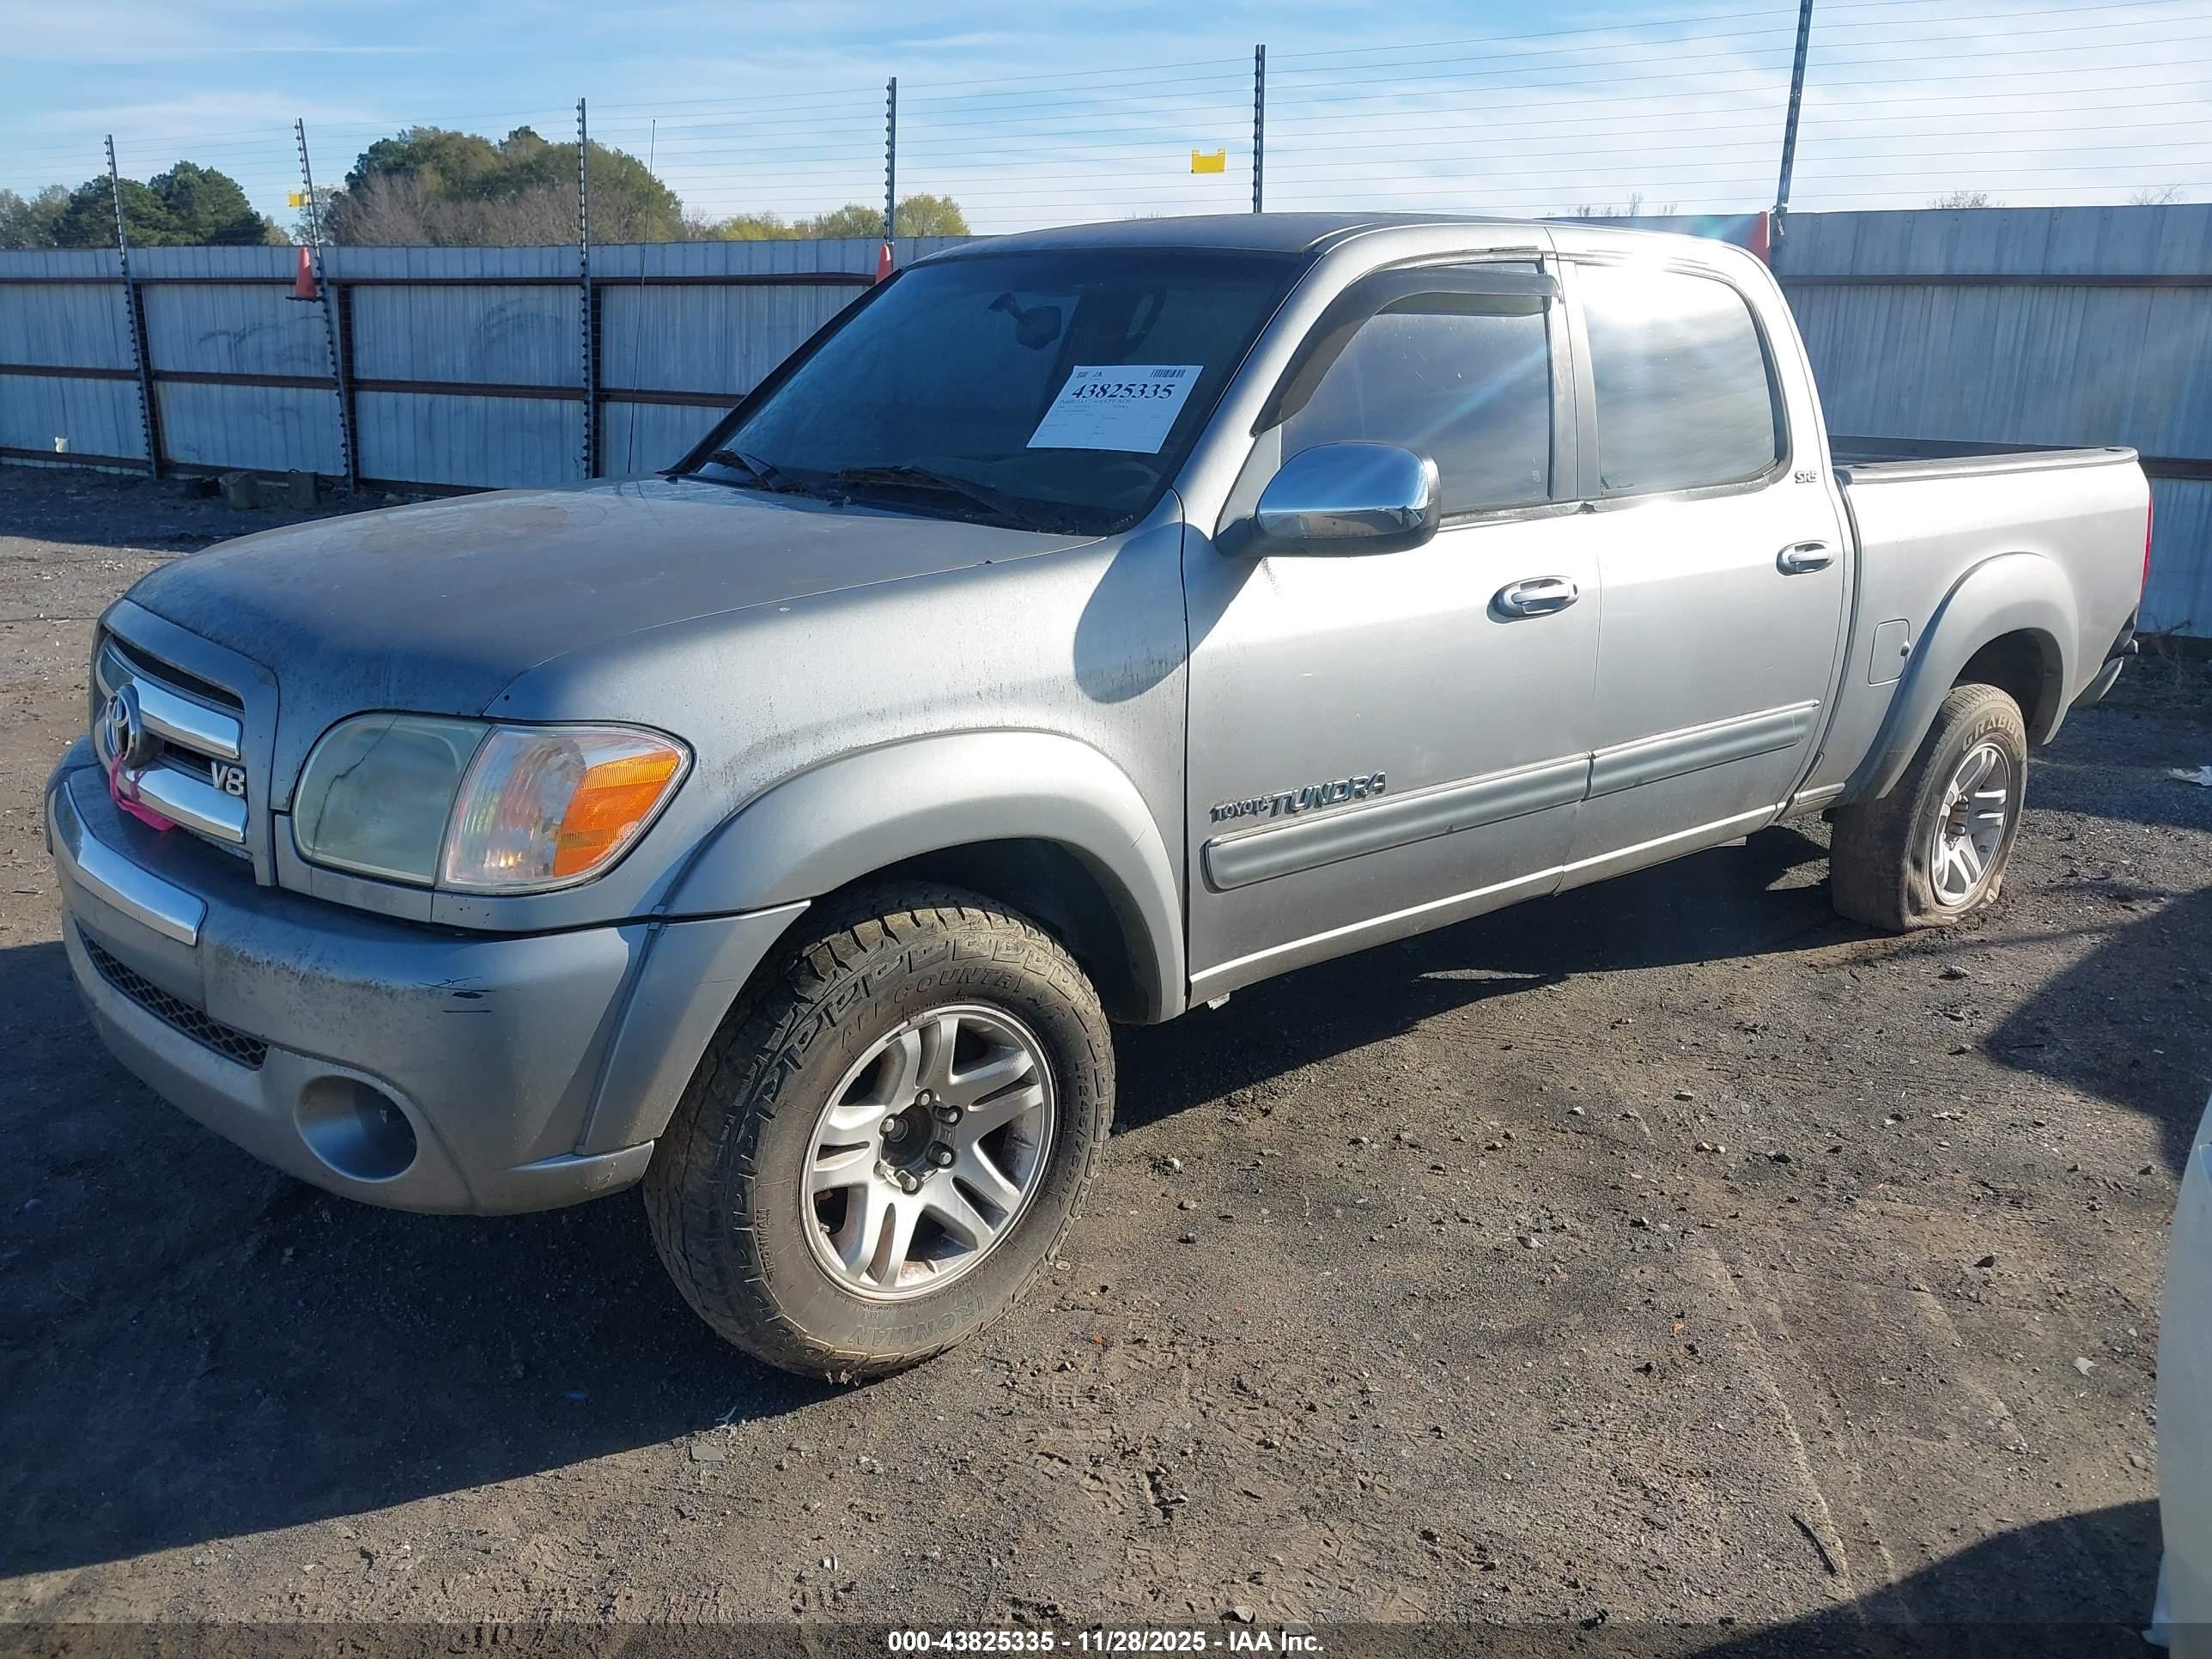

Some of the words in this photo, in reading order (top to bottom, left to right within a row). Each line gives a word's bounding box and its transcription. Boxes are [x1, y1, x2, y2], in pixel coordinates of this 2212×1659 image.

[1072, 383, 1176, 398] 43825335
[211, 761, 246, 796] V8
[1269, 770, 1387, 818] TUNDRA
[847, 1292, 987, 1348] IRONMAN
